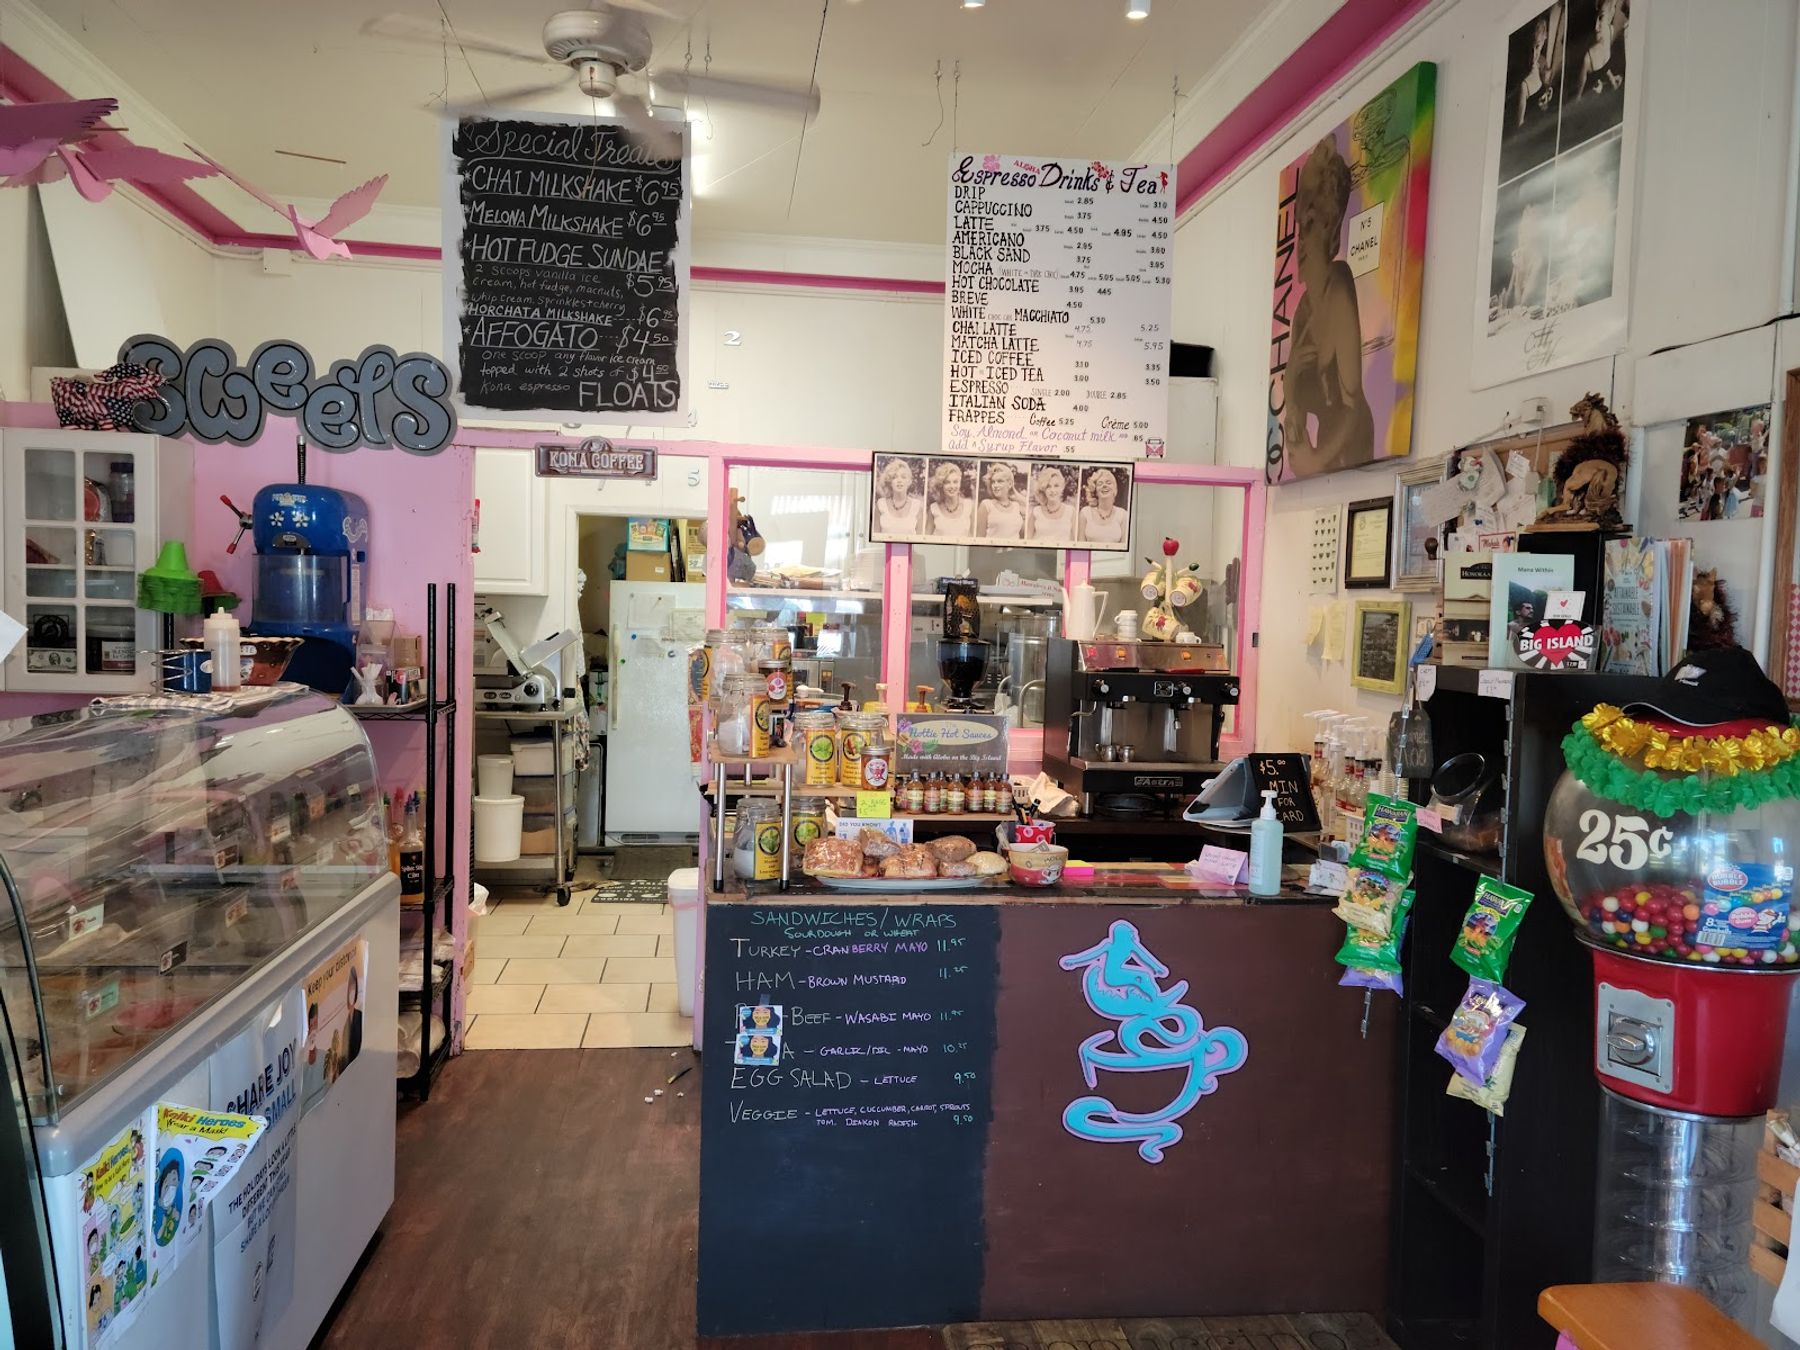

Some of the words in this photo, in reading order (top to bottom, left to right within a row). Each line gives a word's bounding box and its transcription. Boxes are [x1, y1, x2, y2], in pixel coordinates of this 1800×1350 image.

[467, 122, 583, 161] Special
[952, 156, 1036, 187] Espresso
[1039, 163, 1100, 192] Drinks
[1120, 165, 1157, 194] Tea
[472, 165, 522, 194] CHAI
[528, 170, 633, 203] MILKSHAKE
[955, 186, 985, 200] DRIP
[955, 200, 1032, 217] CAPPUCCINO
[470, 201, 526, 225] MELONA
[529, 205, 624, 237] MILKSHAKE
[954, 216, 994, 231] LATTE
[952, 231, 1024, 247] AMERICANO
[1350, 235, 1378, 256] CHANEL
[471, 234, 516, 261] HOT
[518, 239, 583, 267] FUDGE
[588, 244, 663, 272] SUNDAE
[953, 246, 995, 261] BLACK
[997, 247, 1030, 263] SAND
[476, 265, 483, 273] 2
[535, 267, 575, 281] vanilla
[582, 274, 600, 284] ice
[953, 261, 993, 275] MOCHA
[520, 279, 538, 290] hot
[952, 276, 976, 290] HOT
[978, 277, 1039, 293] CHOCOLATE
[1269, 167, 1300, 416] CHANEL
[471, 293, 497, 304] whip
[952, 292, 988, 305] BREVE
[468, 303, 541, 318] HORCHATA
[547, 307, 613, 326] MILKSHAKE
[952, 306, 985, 320] WHITE
[1015, 308, 1069, 324] MACCHIATO
[470, 317, 598, 347] AFFOGATO
[953, 321, 979, 335] CHAI
[983, 322, 1017, 337] LATTE
[951, 336, 997, 350] MATCHA
[1002, 337, 1039, 352] LATTE
[512, 351, 547, 365] scoop
[555, 352, 575, 364] any
[579, 351, 607, 362] flavor
[610, 354, 625, 363] ice
[626, 356, 655, 365] cream
[952, 350, 982, 364] ICED
[988, 352, 1034, 366] COFFEE
[480, 363, 517, 376] topped
[525, 364, 551, 375] with
[558, 366, 568, 376] 2
[573, 364, 605, 376] shots
[609, 367, 625, 377] of
[951, 365, 977, 379] HOT
[986, 366, 1017, 381] ICED
[1023, 368, 1044, 382] TEA
[519, 384, 570, 396] espresso
[579, 381, 677, 408] FLOATS
[950, 380, 1009, 394] ESPRESSO
[949, 395, 1005, 409] ITALIAN
[1011, 396, 1046, 411] SODA
[949, 410, 1005, 424] FRAPPES
[1030, 413, 1056, 427] Coffee
[977, 425, 1025, 439] Almond
[1042, 428, 1086, 442] Coconut
[1091, 429, 1116, 442] milk
[979, 439, 1015, 453] Syrup
[1020, 441, 1057, 453] Flavor
[550, 452, 587, 468] KONA
[592, 452, 644, 470] COFFEE
[1520, 639, 1542, 651] BIG
[1547, 635, 1593, 650] ISLAND
[941, 728, 958, 738] Hot
[962, 729, 992, 738] Sauces
[1269, 780, 1298, 794] MIN
[1278, 798, 1296, 806] FOR
[1276, 810, 1304, 821] ARD
[1576, 809, 1673, 871] 25¢
[895, 913, 957, 928] WRAPS
[784, 927, 851, 939] SOURDOUGH
[864, 930, 879, 938] OR
[883, 929, 920, 938] WHEAT
[730, 938, 801, 958] TURKEY
[895, 941, 928, 952] MAYO
[308, 977, 322, 998] Keep
[736, 971, 795, 991] HAM
[853, 974, 907, 985] MUSTARD
[791, 1007, 831, 1025] BEEF
[902, 1012, 932, 1022] MAYO
[276, 1038, 297, 1085] JOY
[731, 1068, 783, 1089] EGG
[790, 1068, 851, 1090] SALAD
[874, 1075, 918, 1086] LETTUCE
[730, 1100, 798, 1123] VEGGIE
[815, 1106, 857, 1117] LETTUCE,
[940, 1103, 971, 1112] SPROUTS
[196, 1116, 246, 1128] Heroes
